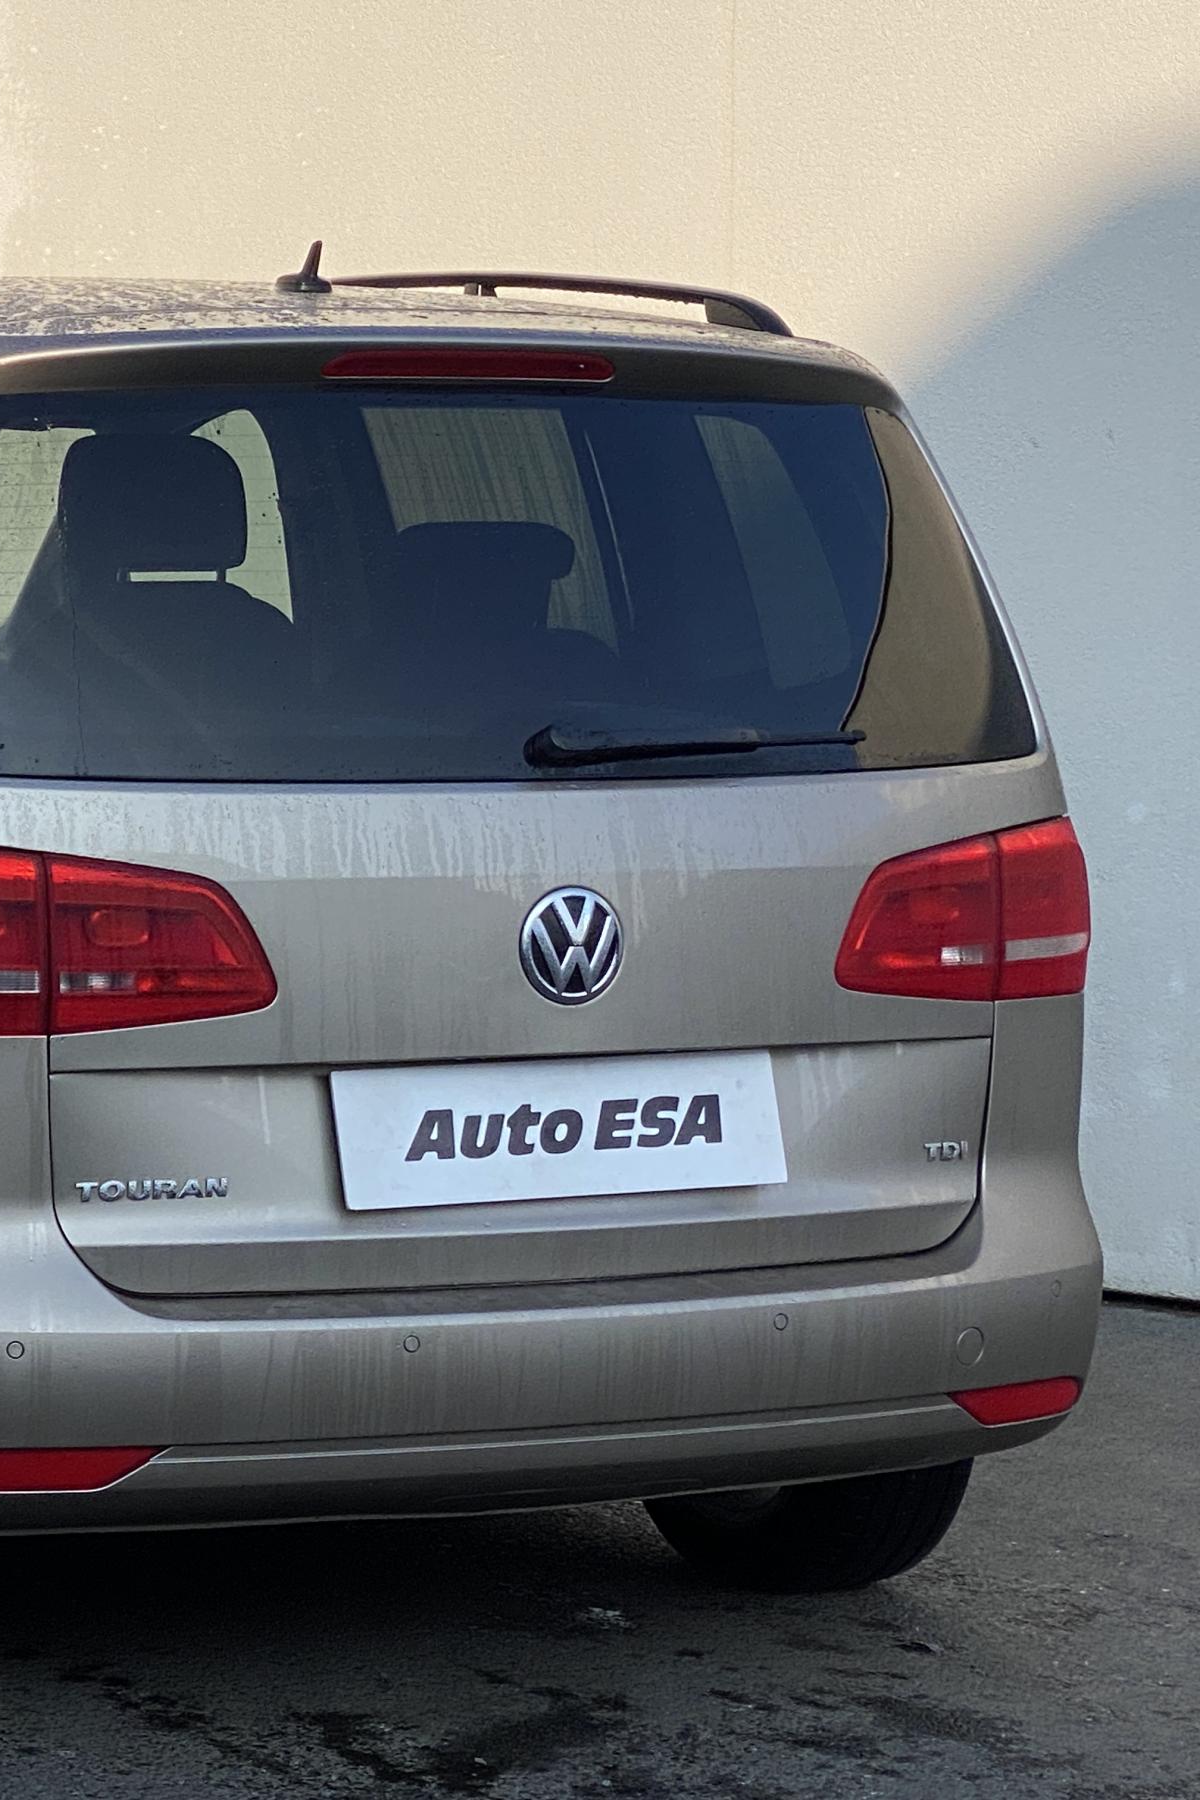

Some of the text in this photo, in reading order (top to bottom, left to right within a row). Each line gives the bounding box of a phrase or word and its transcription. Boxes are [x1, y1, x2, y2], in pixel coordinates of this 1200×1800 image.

[519, 885, 623, 1006] VW
[405, 1093, 723, 1162] Auto ESA
[923, 1140, 968, 1161] TDI
[75, 1177, 228, 1202] TOURAN
